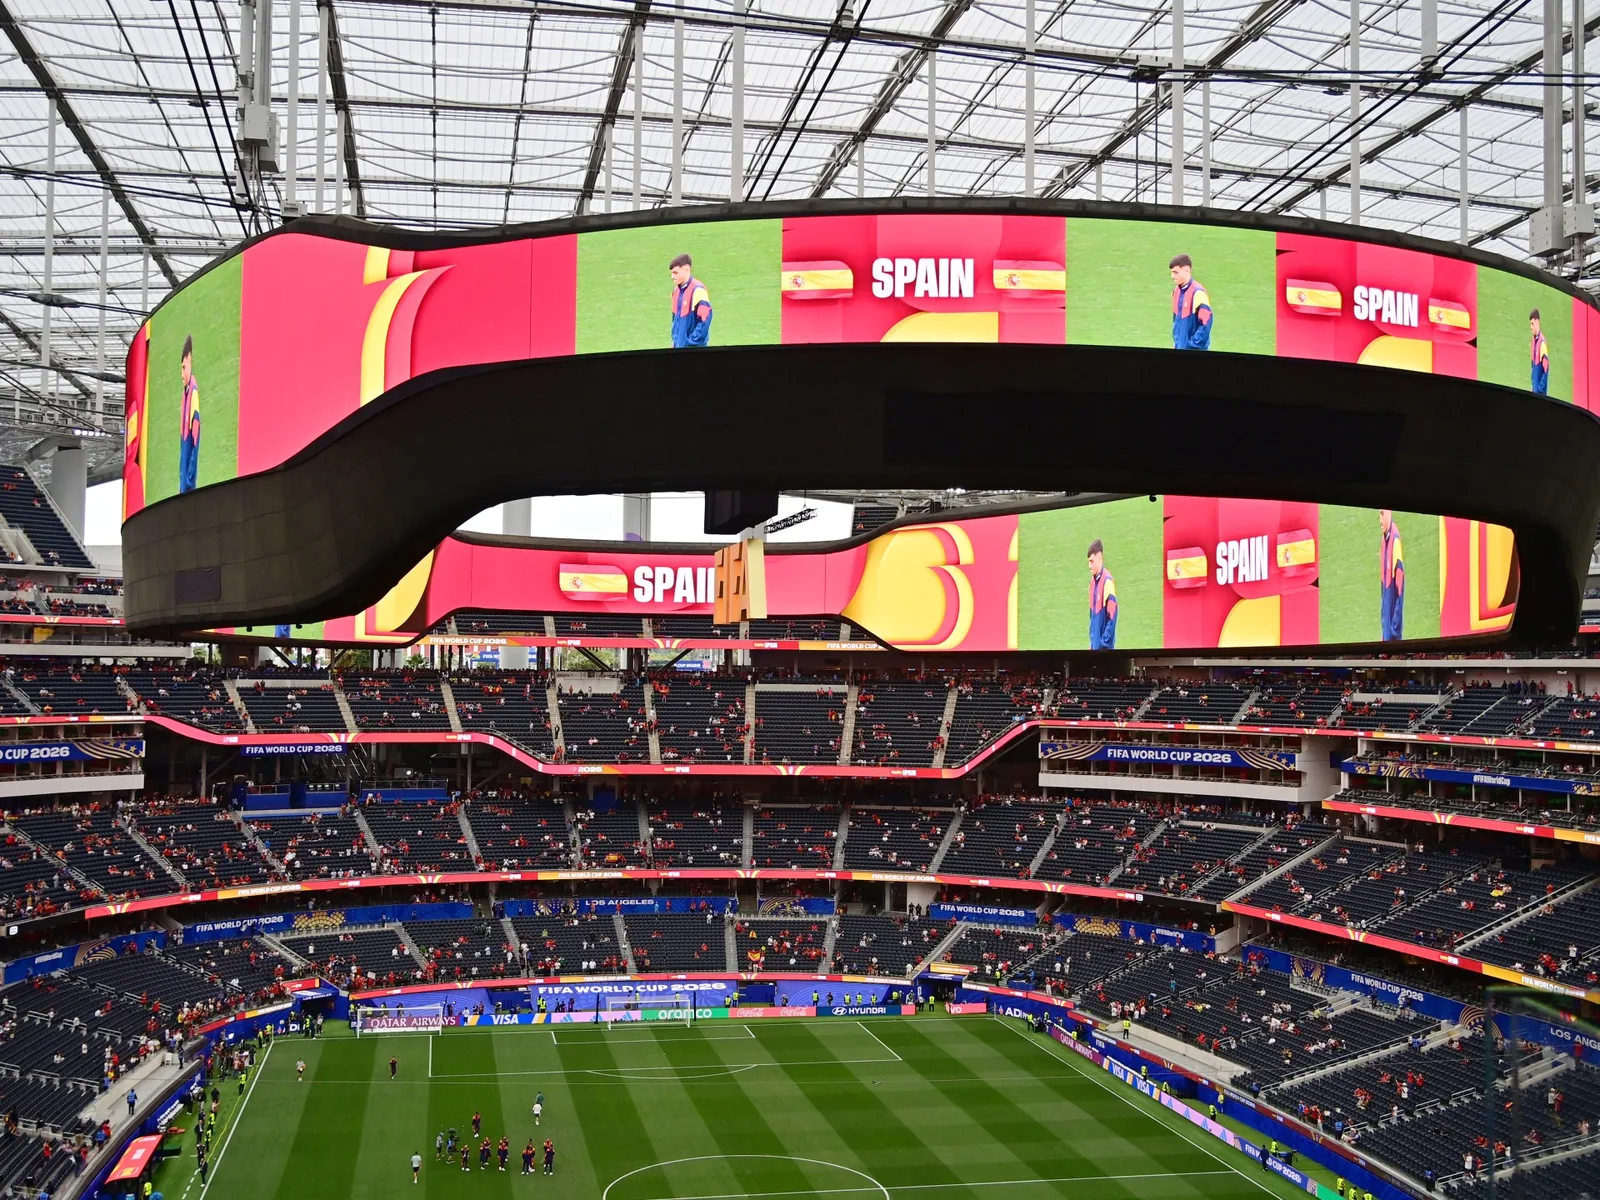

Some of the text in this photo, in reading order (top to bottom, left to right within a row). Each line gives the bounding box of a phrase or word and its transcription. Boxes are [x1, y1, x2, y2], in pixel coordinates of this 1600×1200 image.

[872, 257, 974, 299] SPAIN
[1353, 285, 1419, 328] SPAIN
[1216, 535, 1268, 585] SPAIN
[4, 748, 28, 760] CUP
[30, 746, 70, 758] 2026
[314, 744, 342, 752] 2026
[1107, 748, 1232, 763] FIFA WORLD CUP 2026
[956, 905, 982, 914] WORLD
[984, 907, 998, 915] CUP
[998, 908, 1025, 917] 2026
[196, 923, 213, 932] FIFA
[214, 920, 242, 931] WORLD
[538, 982, 727, 994] FIFA WORLD CUP 2026
[1351, 974, 1424, 1002] FIFA WORLD CUP 2026
[1522, 976, 1535, 986] FIFA
[1534, 979, 1554, 992] WORLD
[490, 1014, 519, 1025] VISA
[658, 1008, 712, 1018] aramco
[371, 1018, 407, 1028] QATAR
[410, 1016, 456, 1026] AIRWAYS
[1550, 1027, 1572, 1040] LOS
[1112, 1062, 1125, 1080] VISA
[1136, 1076, 1150, 1096] VISA
